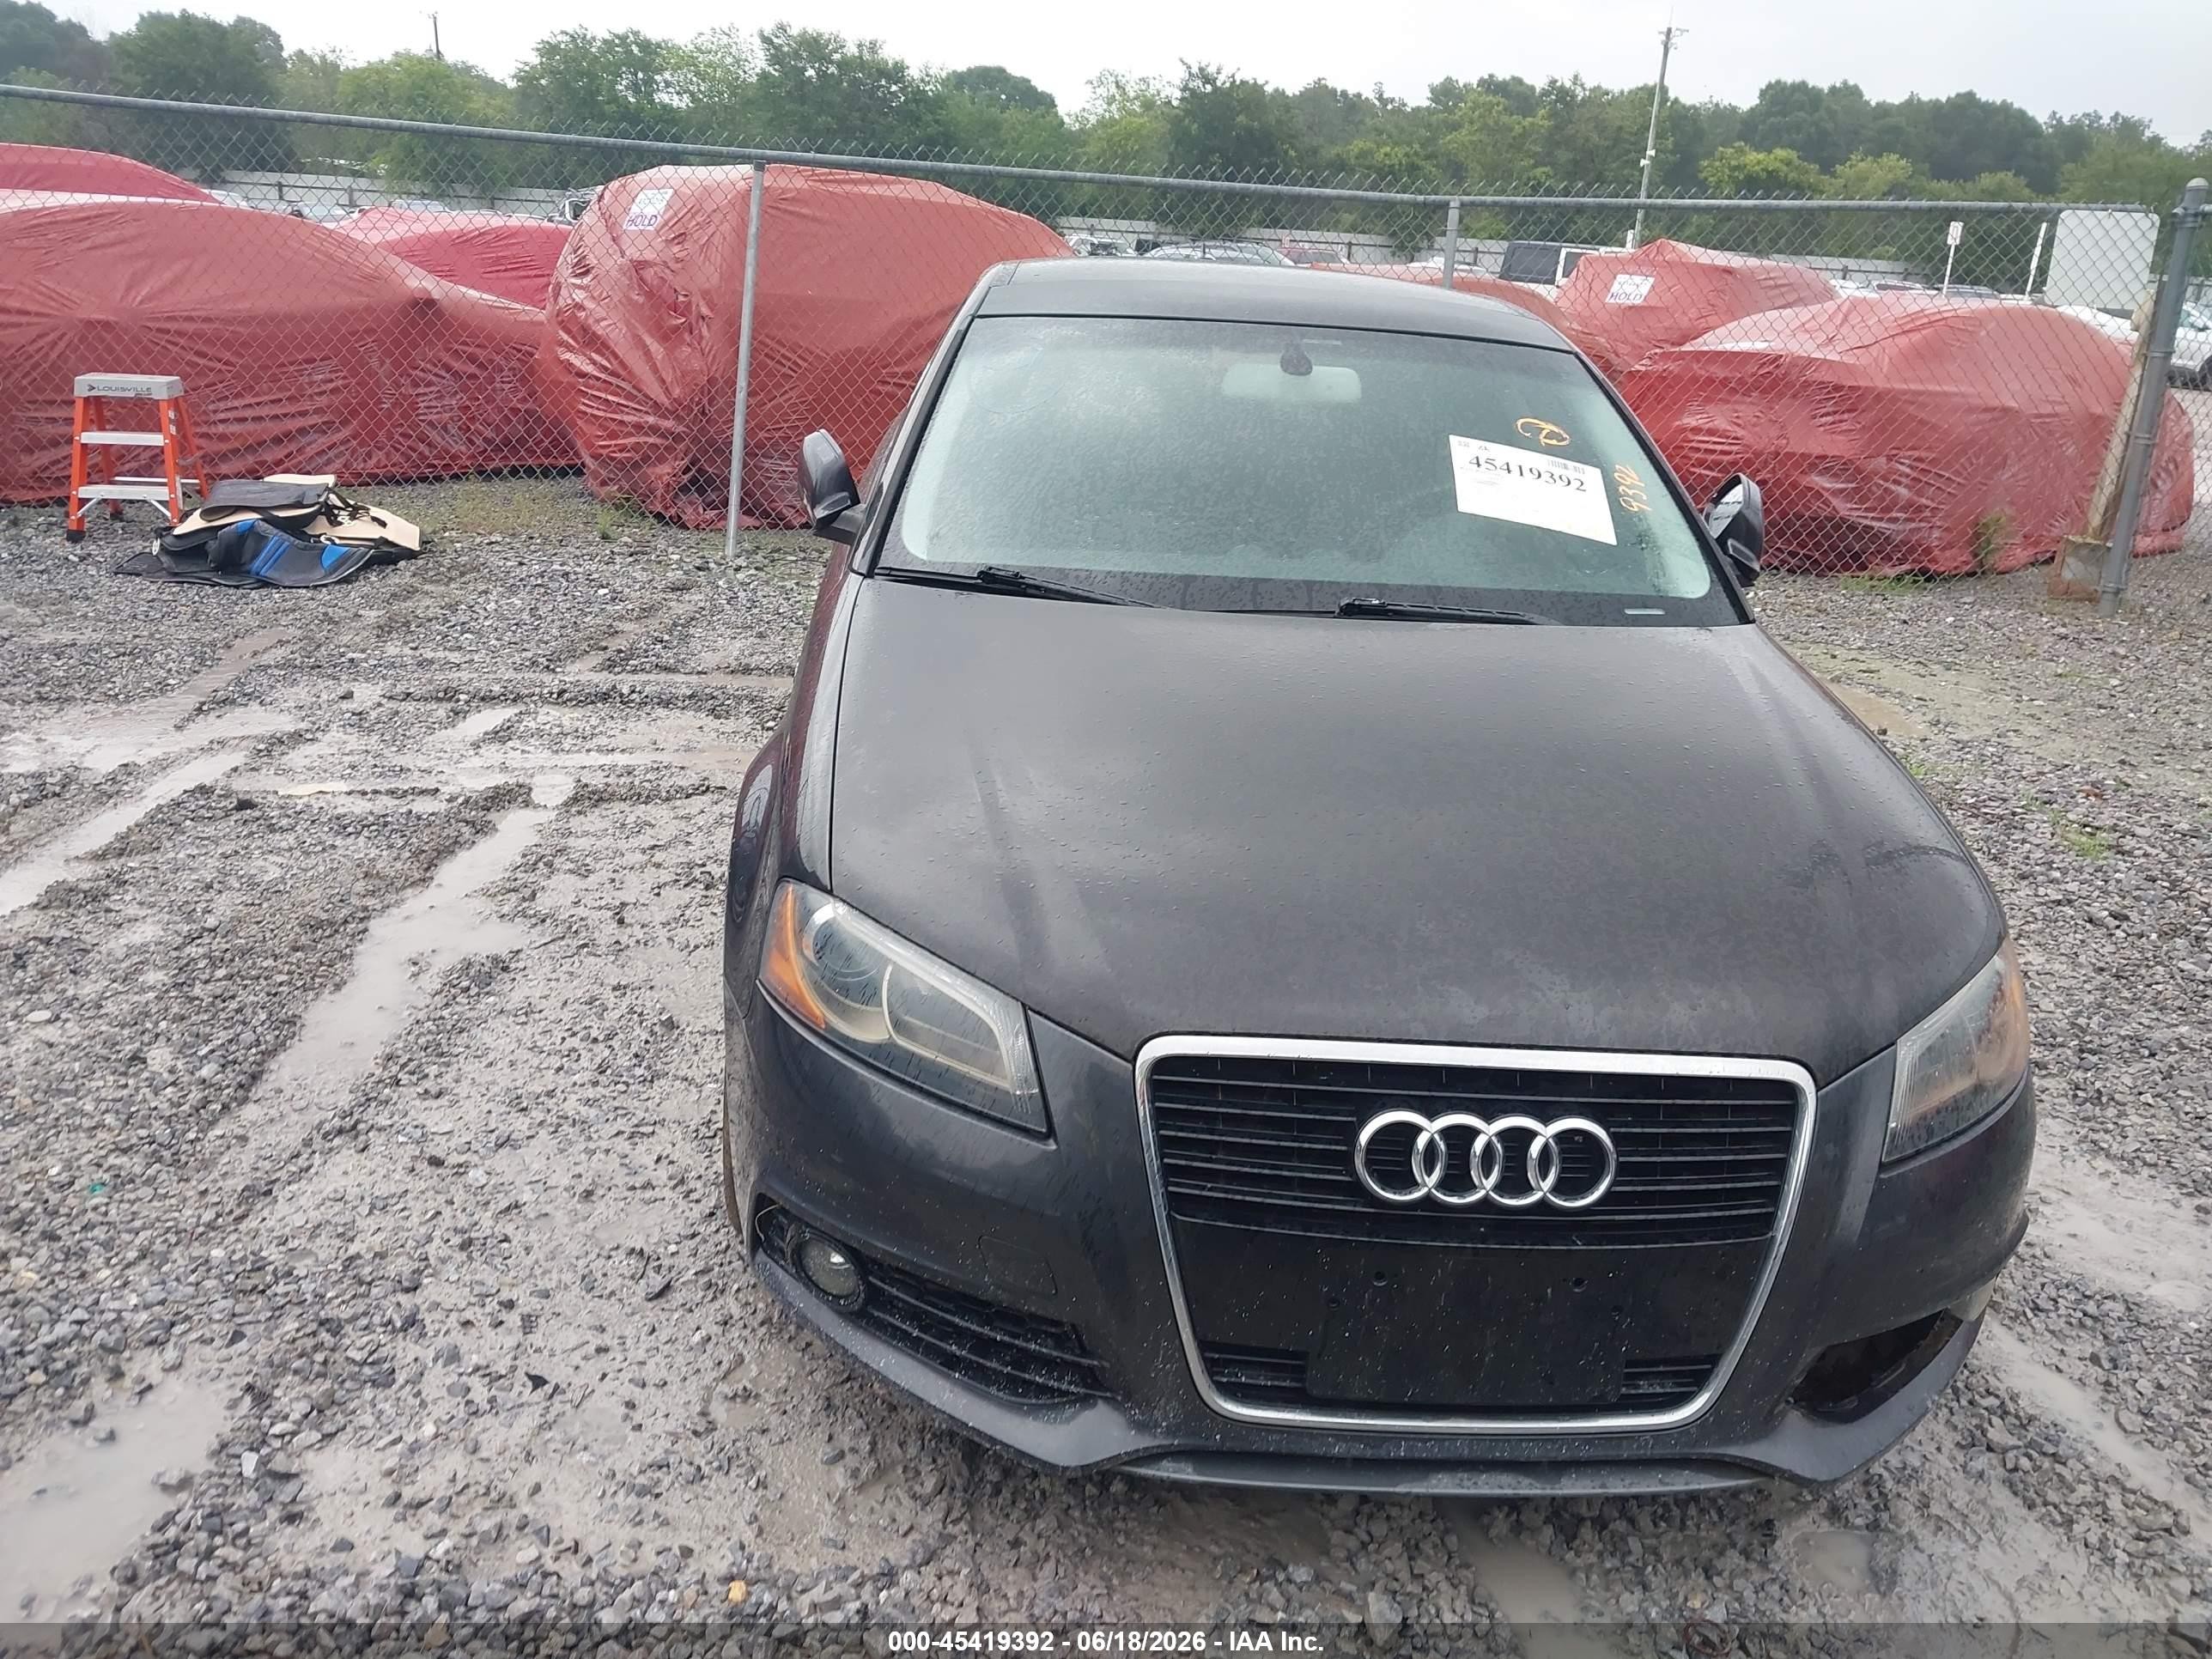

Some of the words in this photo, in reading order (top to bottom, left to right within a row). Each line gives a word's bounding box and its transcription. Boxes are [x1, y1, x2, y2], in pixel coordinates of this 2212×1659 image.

[626, 214, 658, 227] HOLD
[1608, 292, 1643, 301] HOLD
[1468, 455, 1587, 492] 45419392
[1613, 464, 1653, 512] 9392
